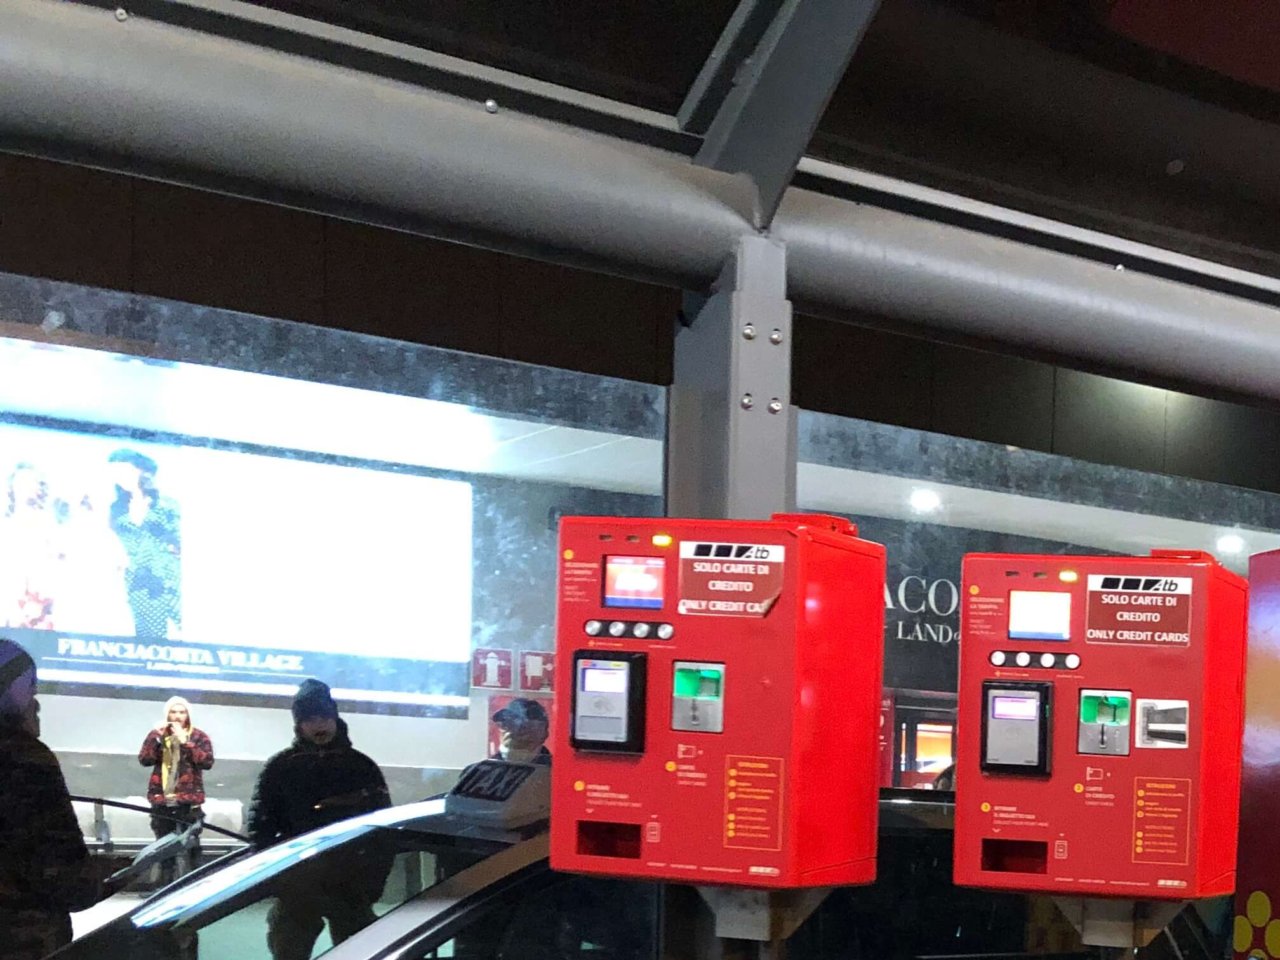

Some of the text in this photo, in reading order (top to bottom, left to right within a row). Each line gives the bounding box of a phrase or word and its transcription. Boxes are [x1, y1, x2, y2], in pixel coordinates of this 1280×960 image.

[693, 562, 770, 575] SOLO CARTE DI
[708, 580, 754, 592] CREDITO
[884, 575, 959, 617] CO
[1101, 594, 1177, 606] SOLO CARTE DI
[679, 599, 708, 610] ONLY
[708, 600, 746, 611] CREDIT
[1116, 611, 1161, 622] CREDITO
[897, 621, 953, 643] LAND
[1087, 629, 1190, 643] ONLY CREDIT CARDS
[216, 650, 304, 670] VILLAGE
[462, 763, 528, 799] TAXI
